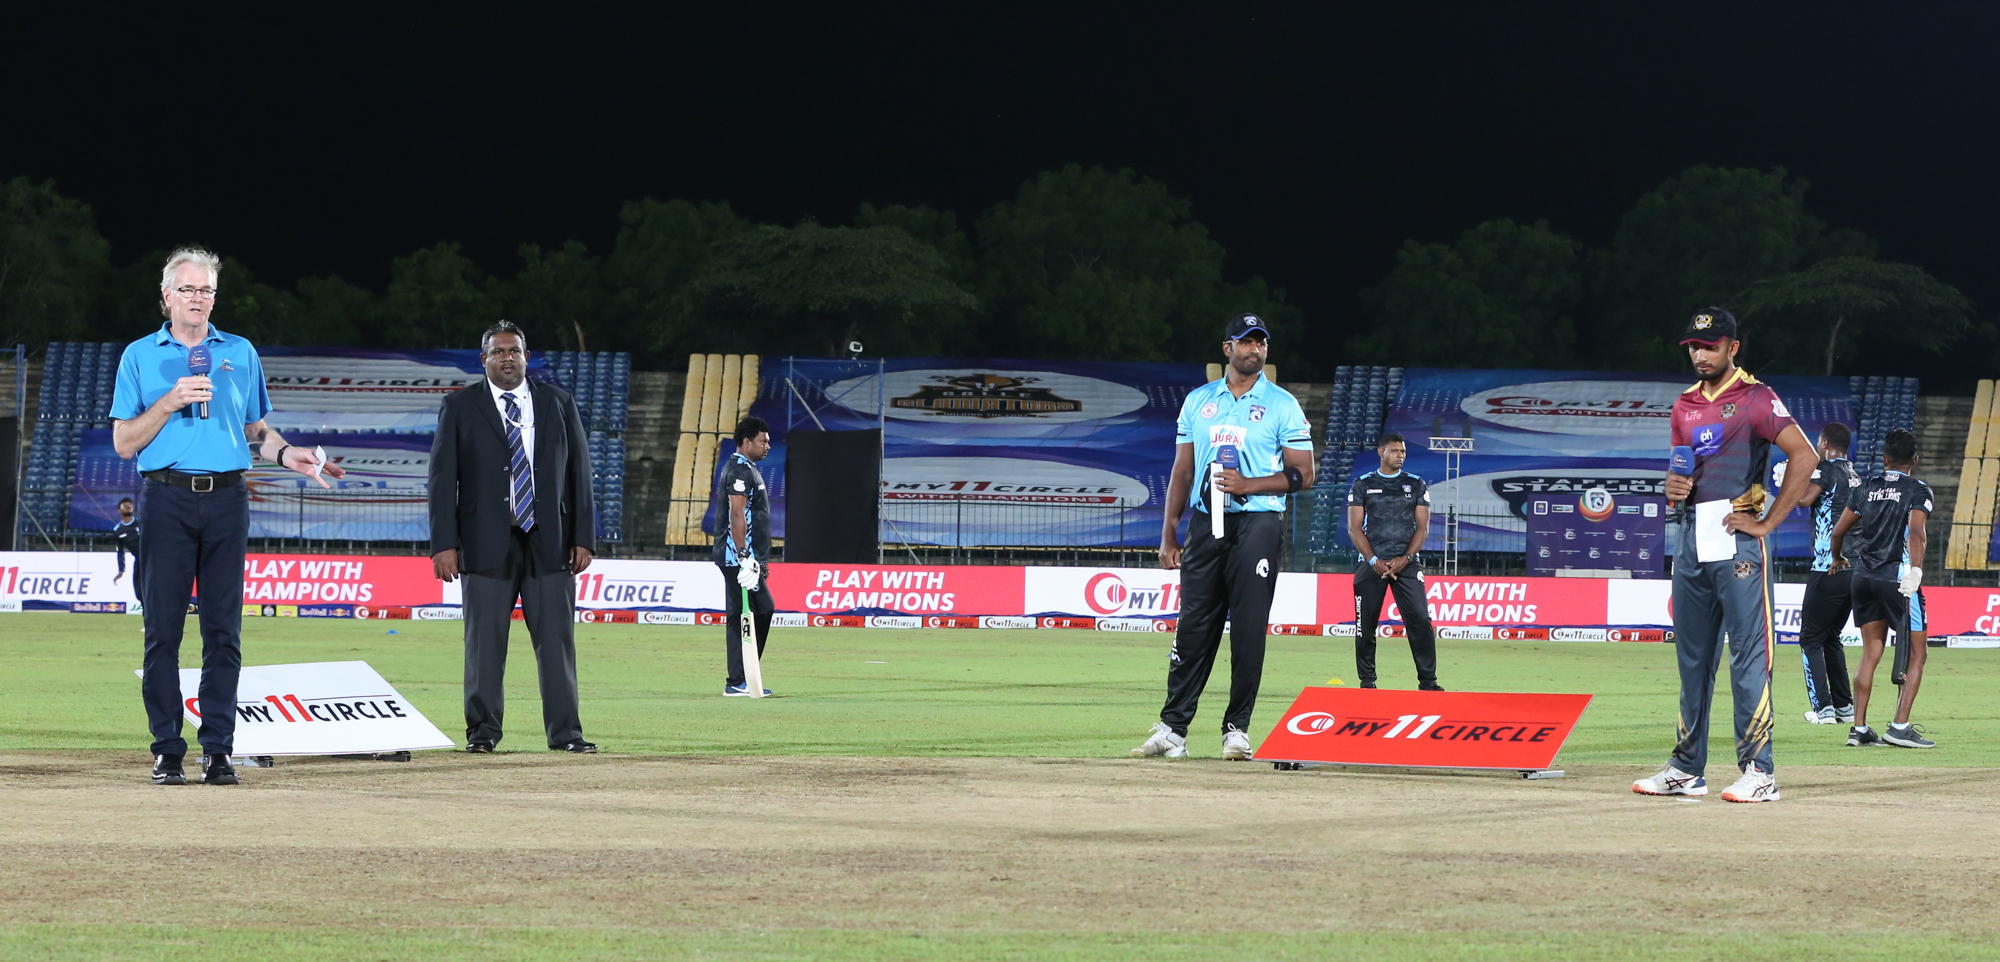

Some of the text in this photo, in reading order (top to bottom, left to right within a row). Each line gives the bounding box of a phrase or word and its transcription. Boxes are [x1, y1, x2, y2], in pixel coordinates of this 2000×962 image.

[1211, 433, 1239, 444] JURA
[893, 481, 1121, 494] MY11CIRCLE
[962, 494, 1102, 503] CHAMPIONS
[300, 561, 363, 580] WITH
[816, 570, 945, 590] PLAY WITH
[243, 581, 373, 602] HAMPIONS
[1464, 582, 1527, 601] WITH
[805, 591, 955, 612] CHAMPIONS
[1452, 630, 1492, 639] MY11CIRCLE
[1564, 631, 1604, 640] MY11CIRCLE
[236, 693, 407, 723] MY11CIRCLE
[1335, 714, 1556, 742] MY11CIRCLE
